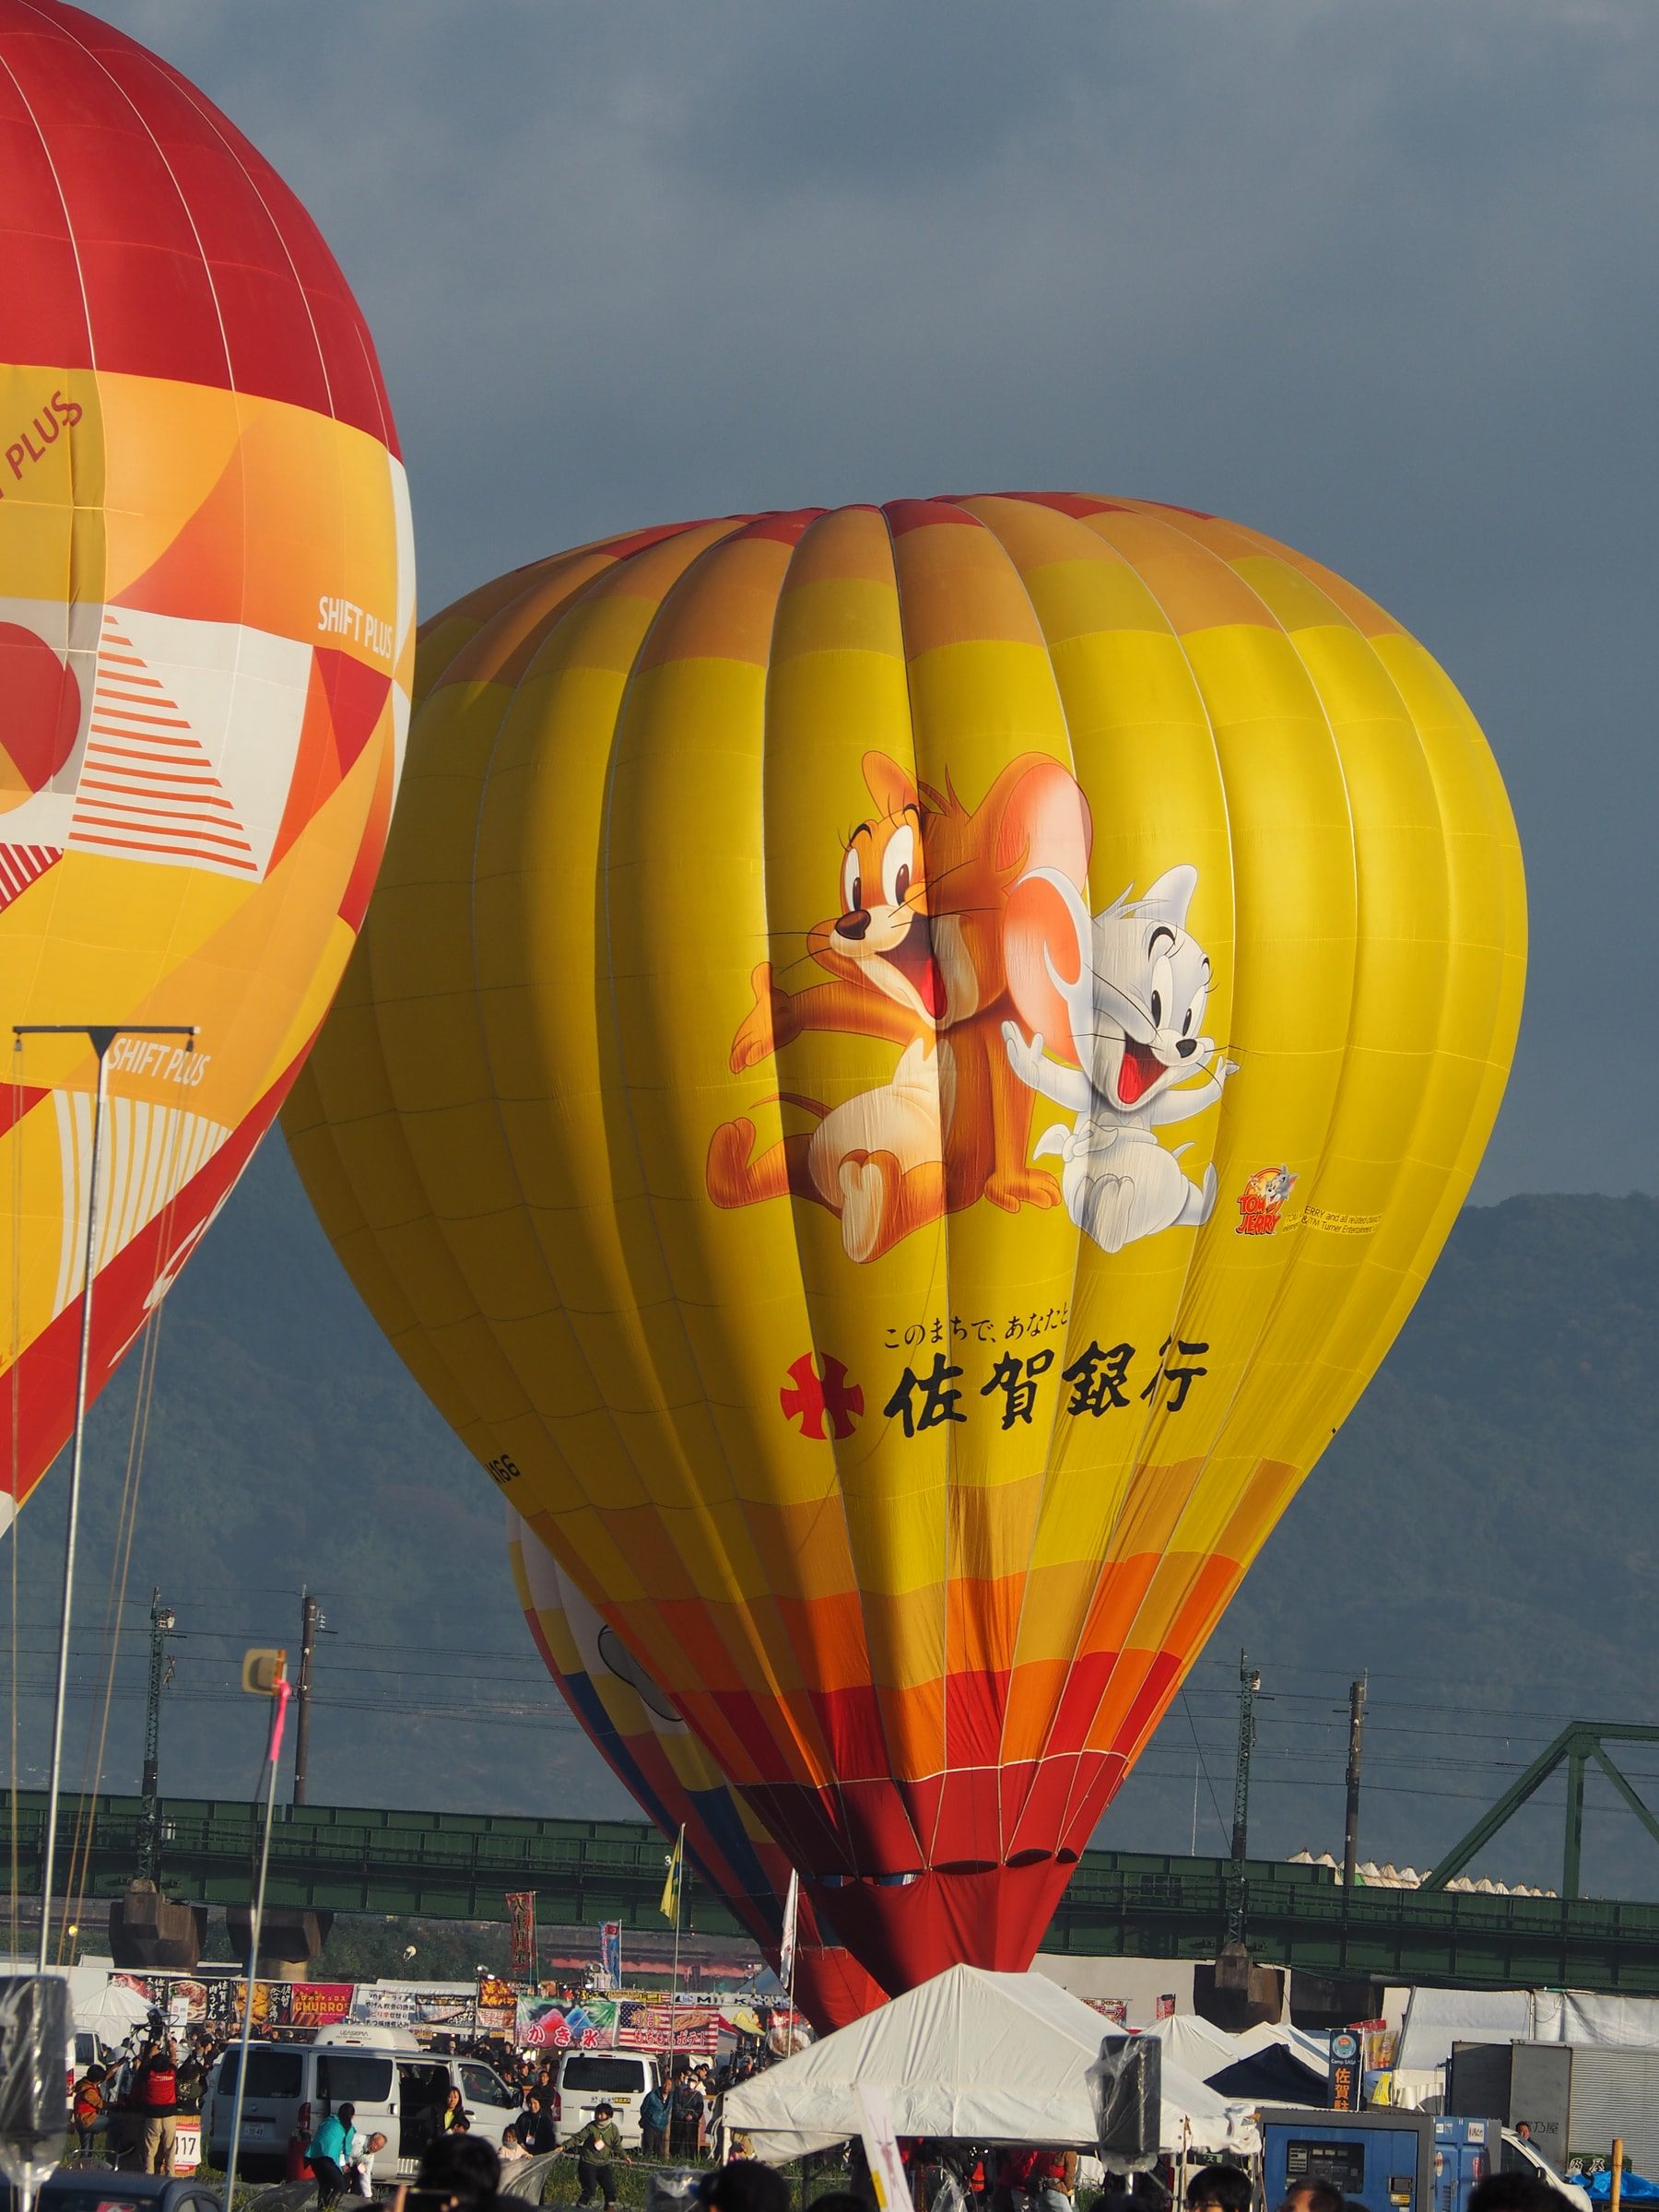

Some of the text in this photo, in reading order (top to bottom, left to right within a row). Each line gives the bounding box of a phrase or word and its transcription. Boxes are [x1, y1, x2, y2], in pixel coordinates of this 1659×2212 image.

[5, 390, 83, 480] PLUS
[317, 595, 393, 659] SHIFT PLUS
[108, 1037, 211, 1088] SHIFT PLUS
[1237, 1194, 1267, 1215] TOM
[1304, 1206, 1326, 1218] ERRY
[1236, 1214, 1282, 1236] JERRY
[883, 1332, 1210, 1438] 佐賀銀行
[207, 1984, 218, 2020] 肉うどん
[527, 2024, 599, 2050] かき氷
[1527, 2121, 1559, 2135] 乃屋
[175, 2136, 196, 2157] 117
